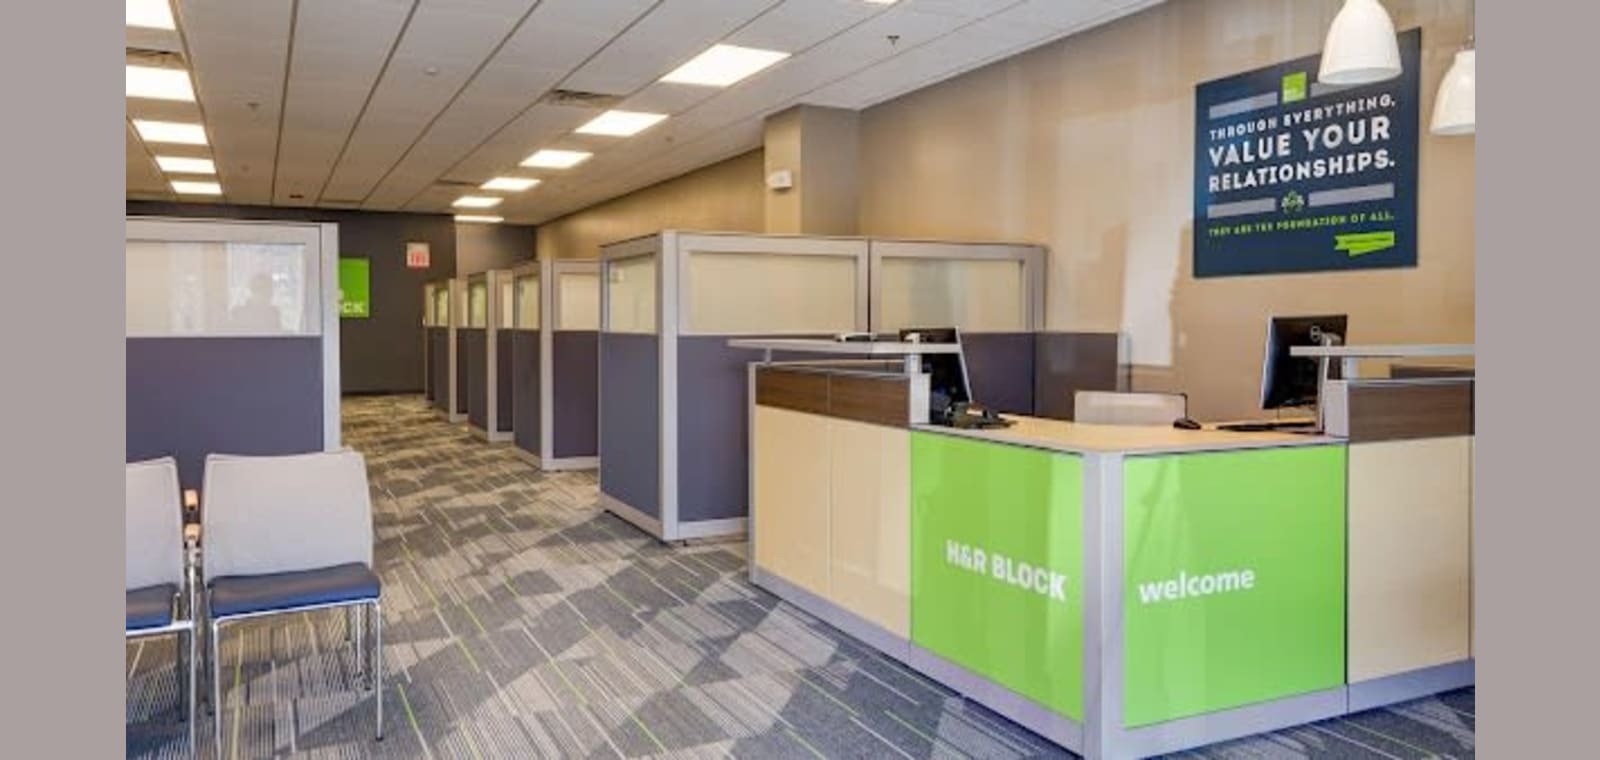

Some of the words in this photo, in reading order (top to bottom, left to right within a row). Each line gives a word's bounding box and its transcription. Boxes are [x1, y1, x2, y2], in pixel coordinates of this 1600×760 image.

[1209, 116, 1278, 141] THROUGH
[1283, 93, 1396, 126] EVERYTHING.
[1208, 133, 1292, 167] VALUE
[1303, 116, 1391, 151] YOUR
[1208, 149, 1396, 193] RELATIONSHIPS.
[1351, 212, 1366, 223] OF
[946, 539, 987, 575] H&R
[991, 556, 1068, 602] BLOCK
[1138, 569, 1255, 604] welcome
